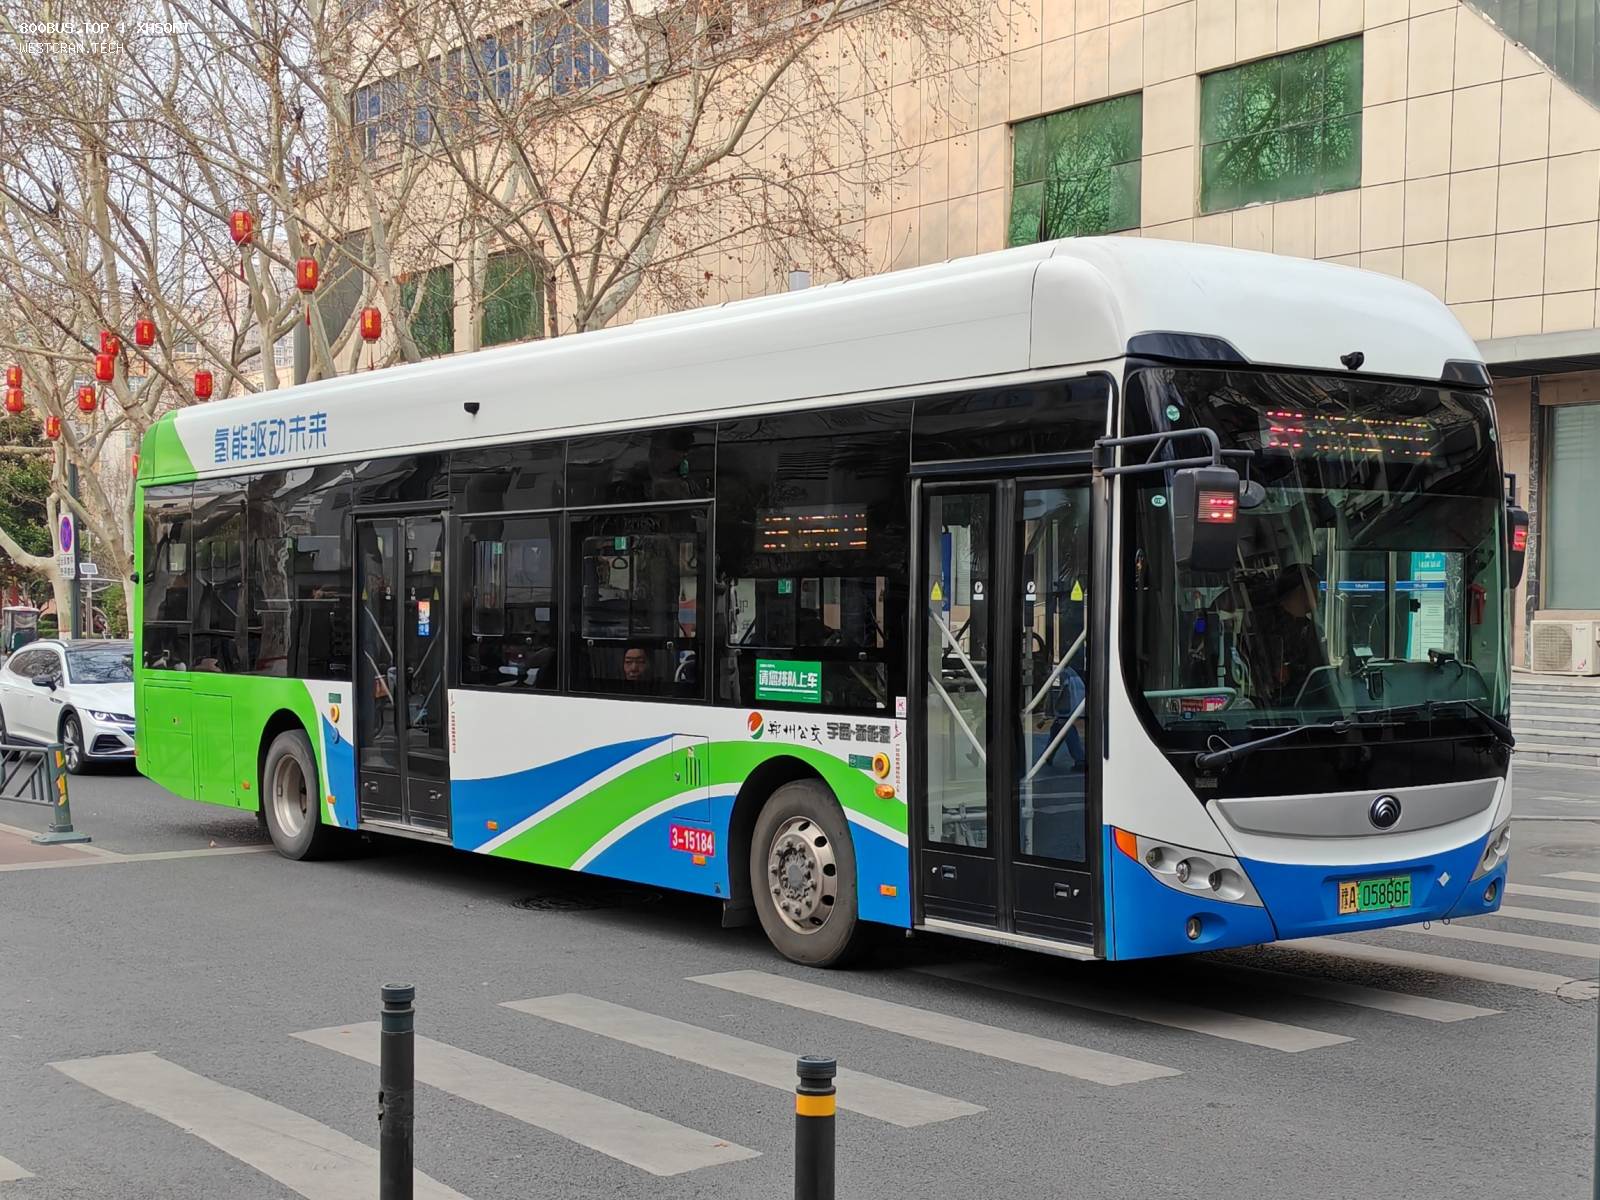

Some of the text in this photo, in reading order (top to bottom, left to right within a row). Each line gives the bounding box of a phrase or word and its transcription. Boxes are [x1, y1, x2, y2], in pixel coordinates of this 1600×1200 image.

[215, 411, 327, 463] 氢能驱动未来
[767, 720, 823, 745] 郑州公交
[671, 827, 714, 854] 3-15184
